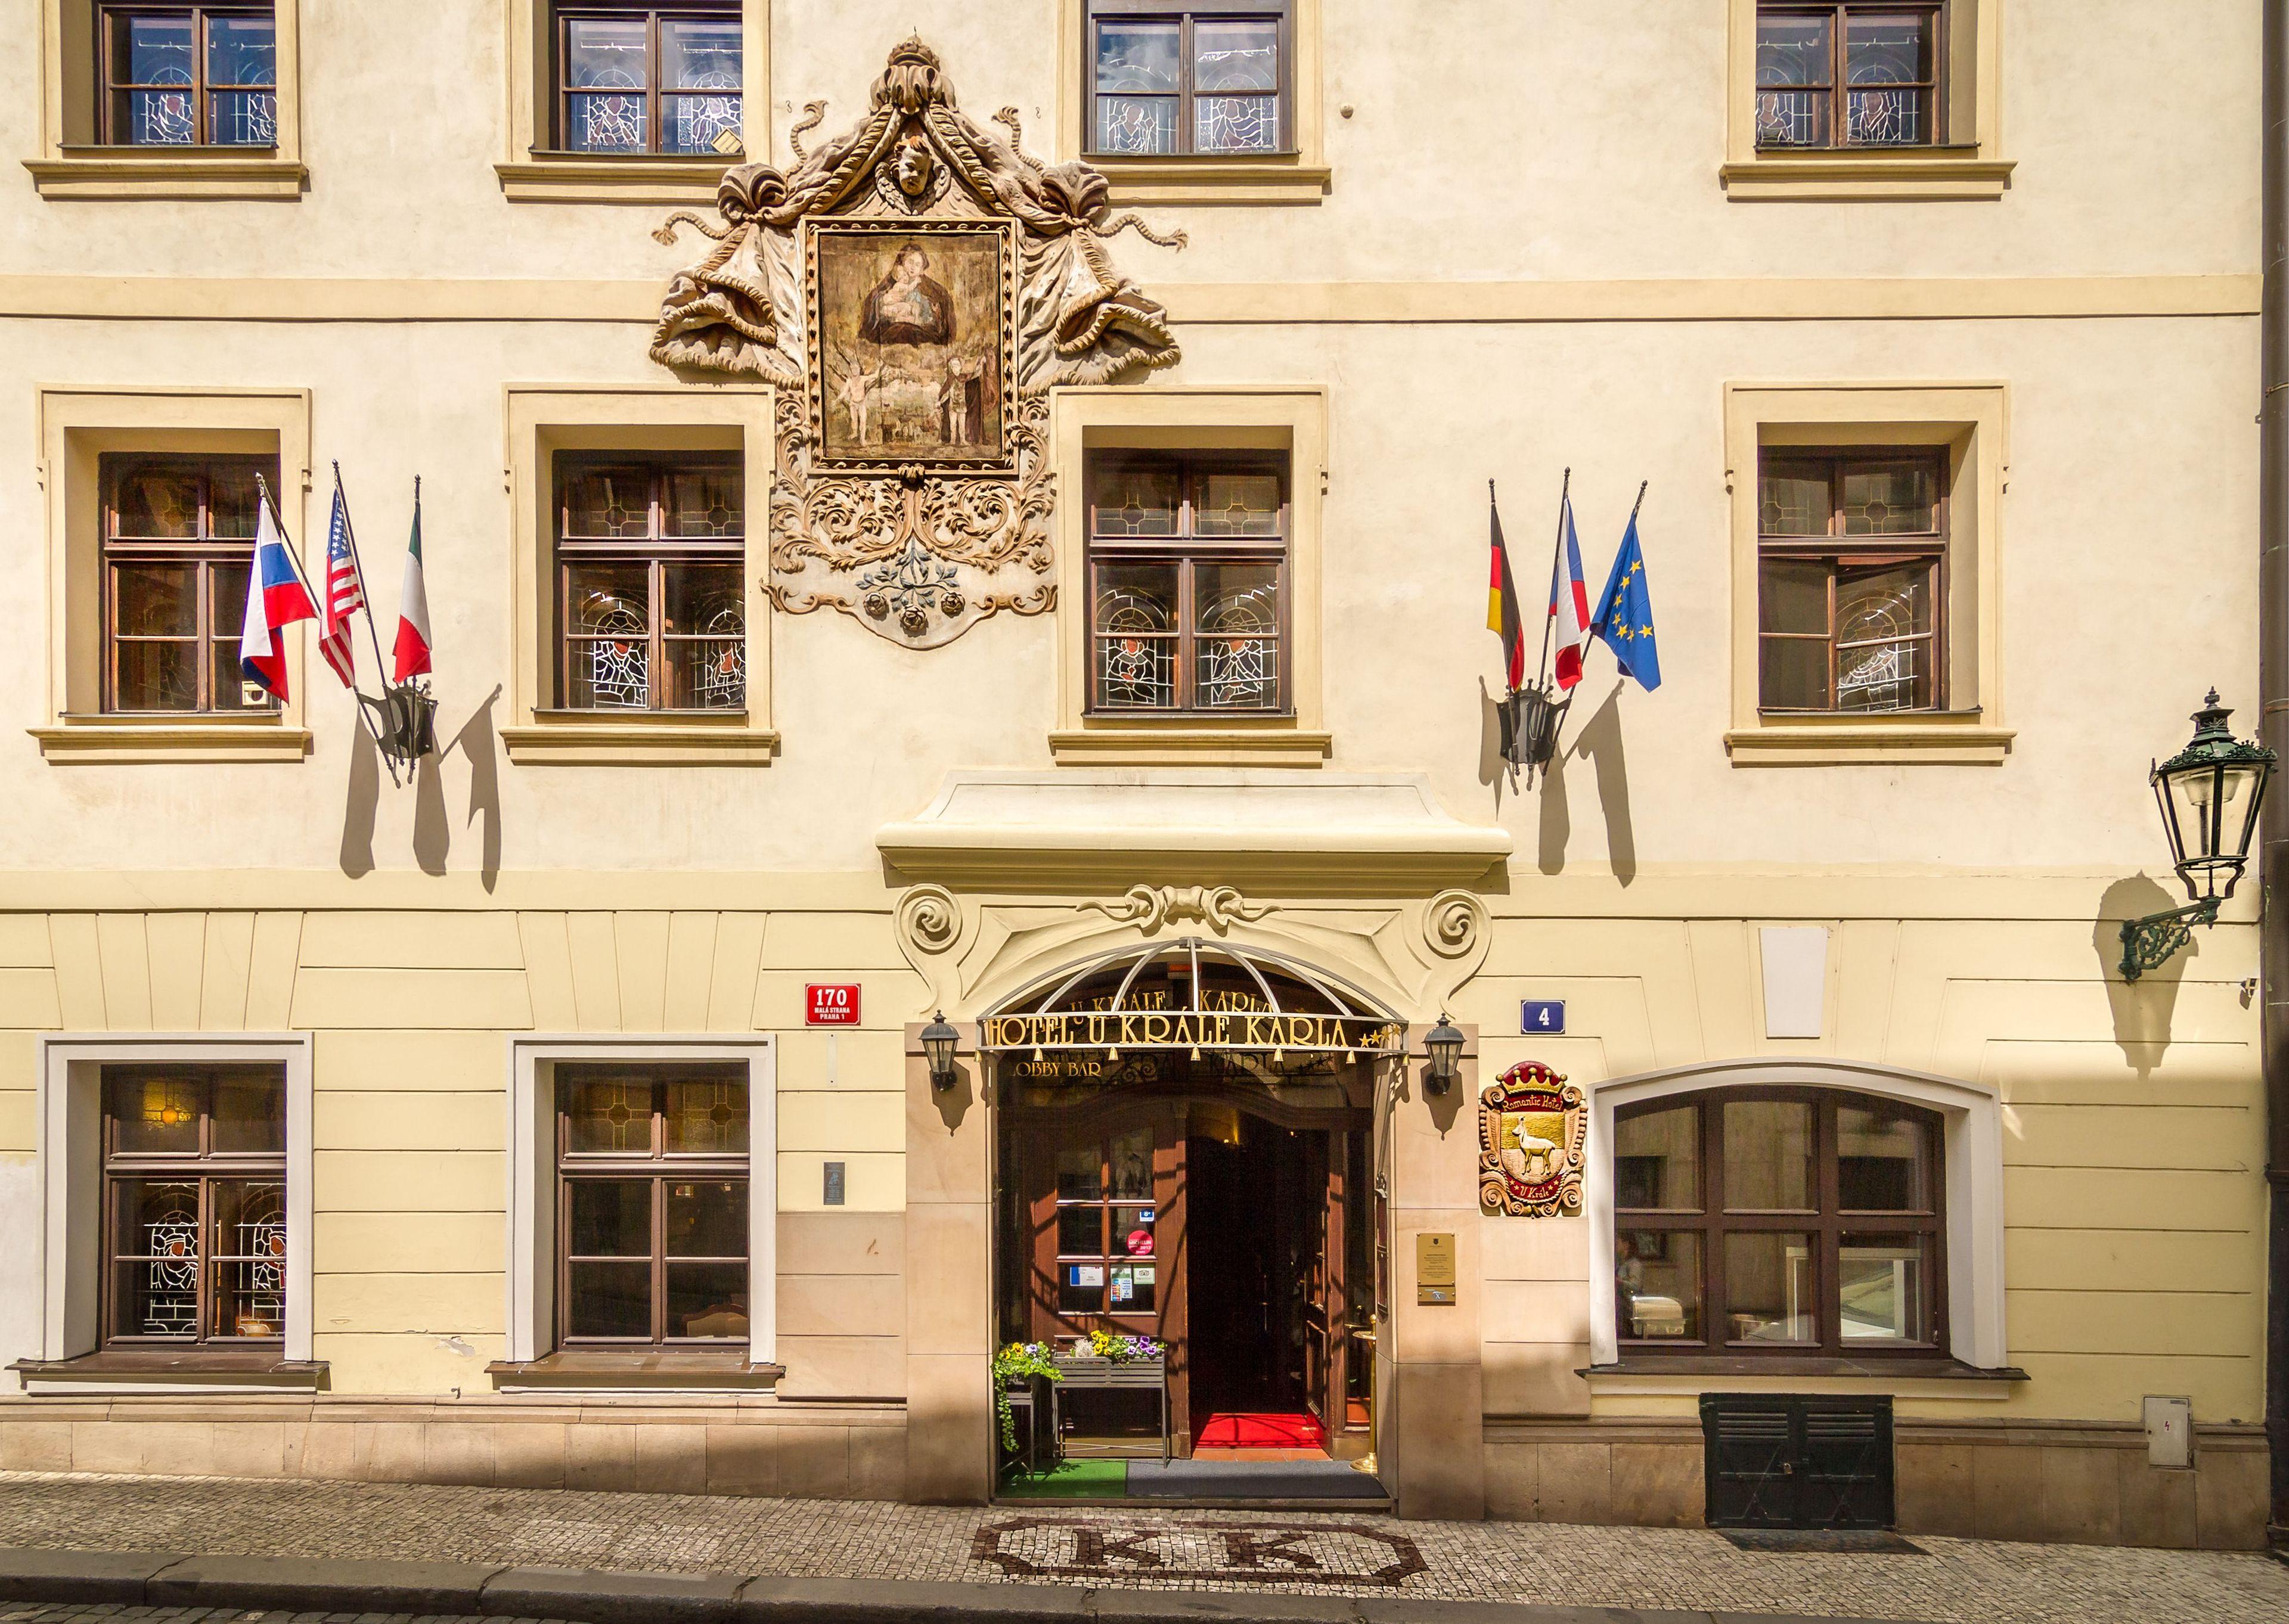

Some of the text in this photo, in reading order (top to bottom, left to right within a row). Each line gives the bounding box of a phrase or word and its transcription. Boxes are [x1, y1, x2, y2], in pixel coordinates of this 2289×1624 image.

[817, 989, 847, 1006] 170
[1071, 1001, 1083, 1024] U
[1539, 1007, 1549, 1026] 4
[988, 1015, 1074, 1046] HOTEL
[1088, 1015, 1108, 1044] U
[1119, 1006, 1230, 1045] KRÁLE
[1244, 1016, 1348, 1048] KARLA
[1068, 1062, 1102, 1077] BAR
[1502, 1094, 1564, 1111] Romantic Hotel
[1520, 1185, 1550, 1198] U Krále
[1074, 1529, 1323, 1569] K K
